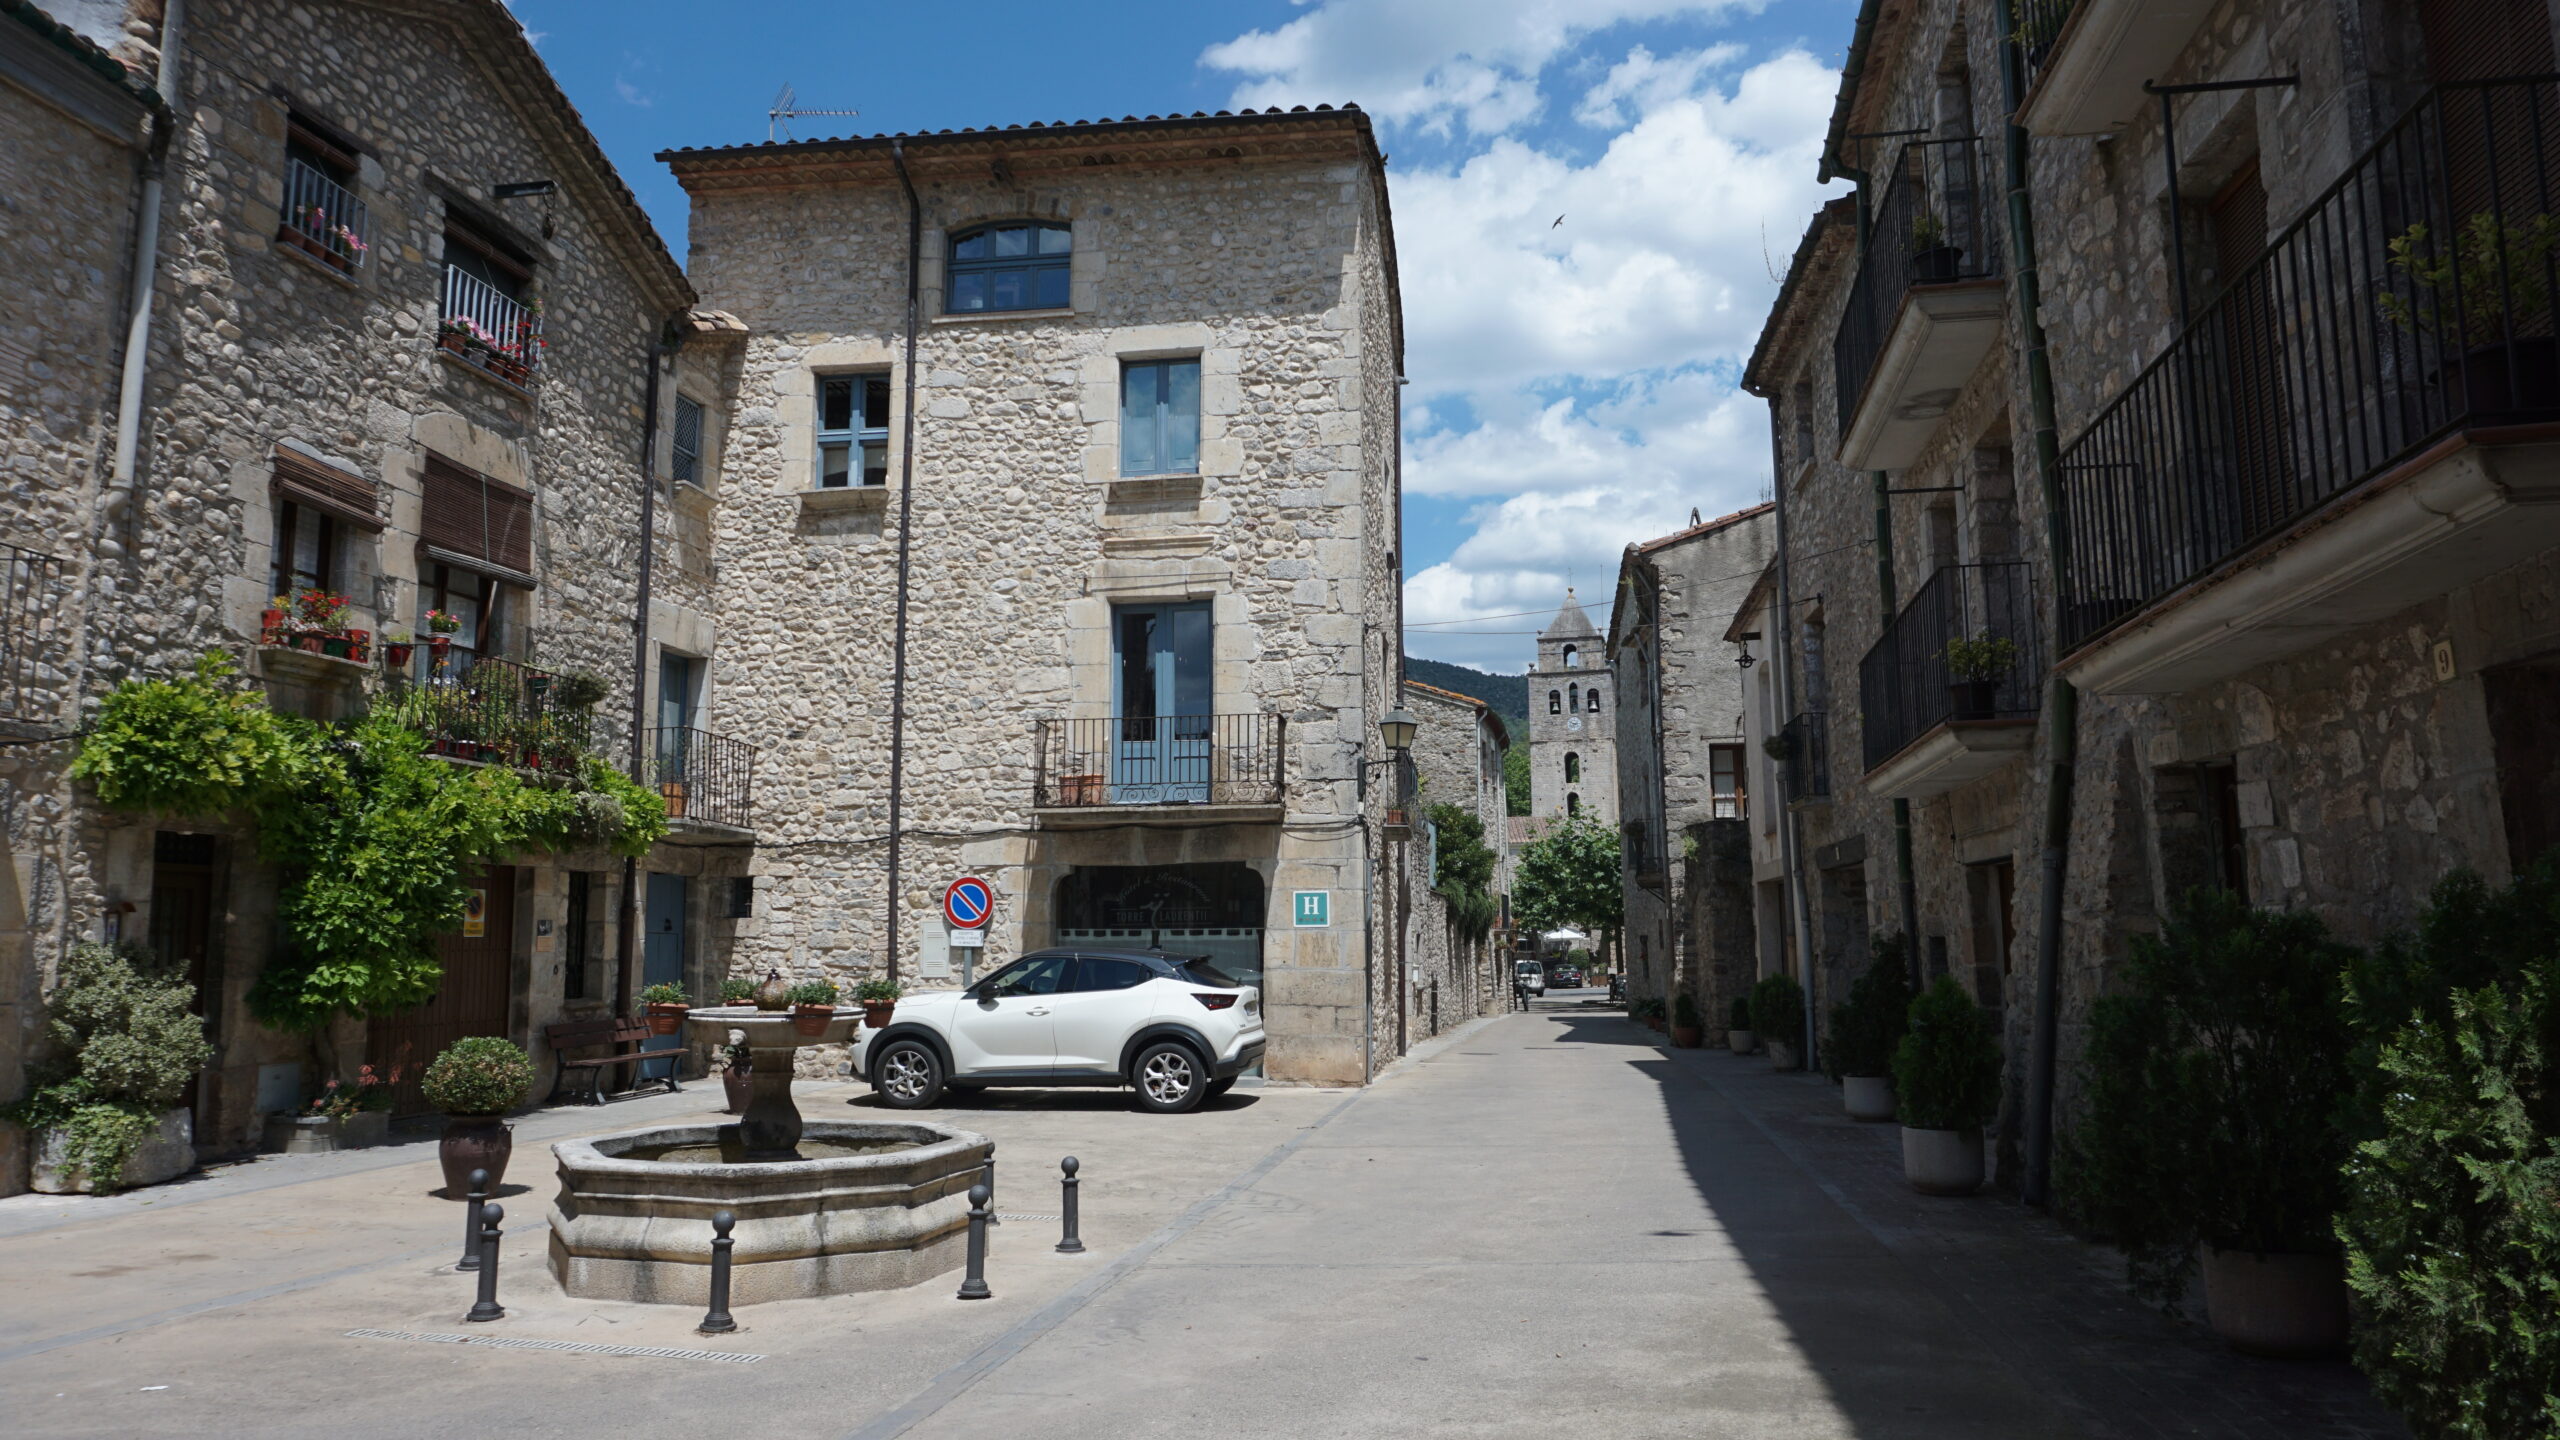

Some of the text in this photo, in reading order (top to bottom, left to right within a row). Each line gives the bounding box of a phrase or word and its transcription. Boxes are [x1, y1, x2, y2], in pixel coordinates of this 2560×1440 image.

[2439, 649, 2448, 673] 9
[1303, 896, 1320, 915] H
[1116, 911, 1145, 922] TORRE
